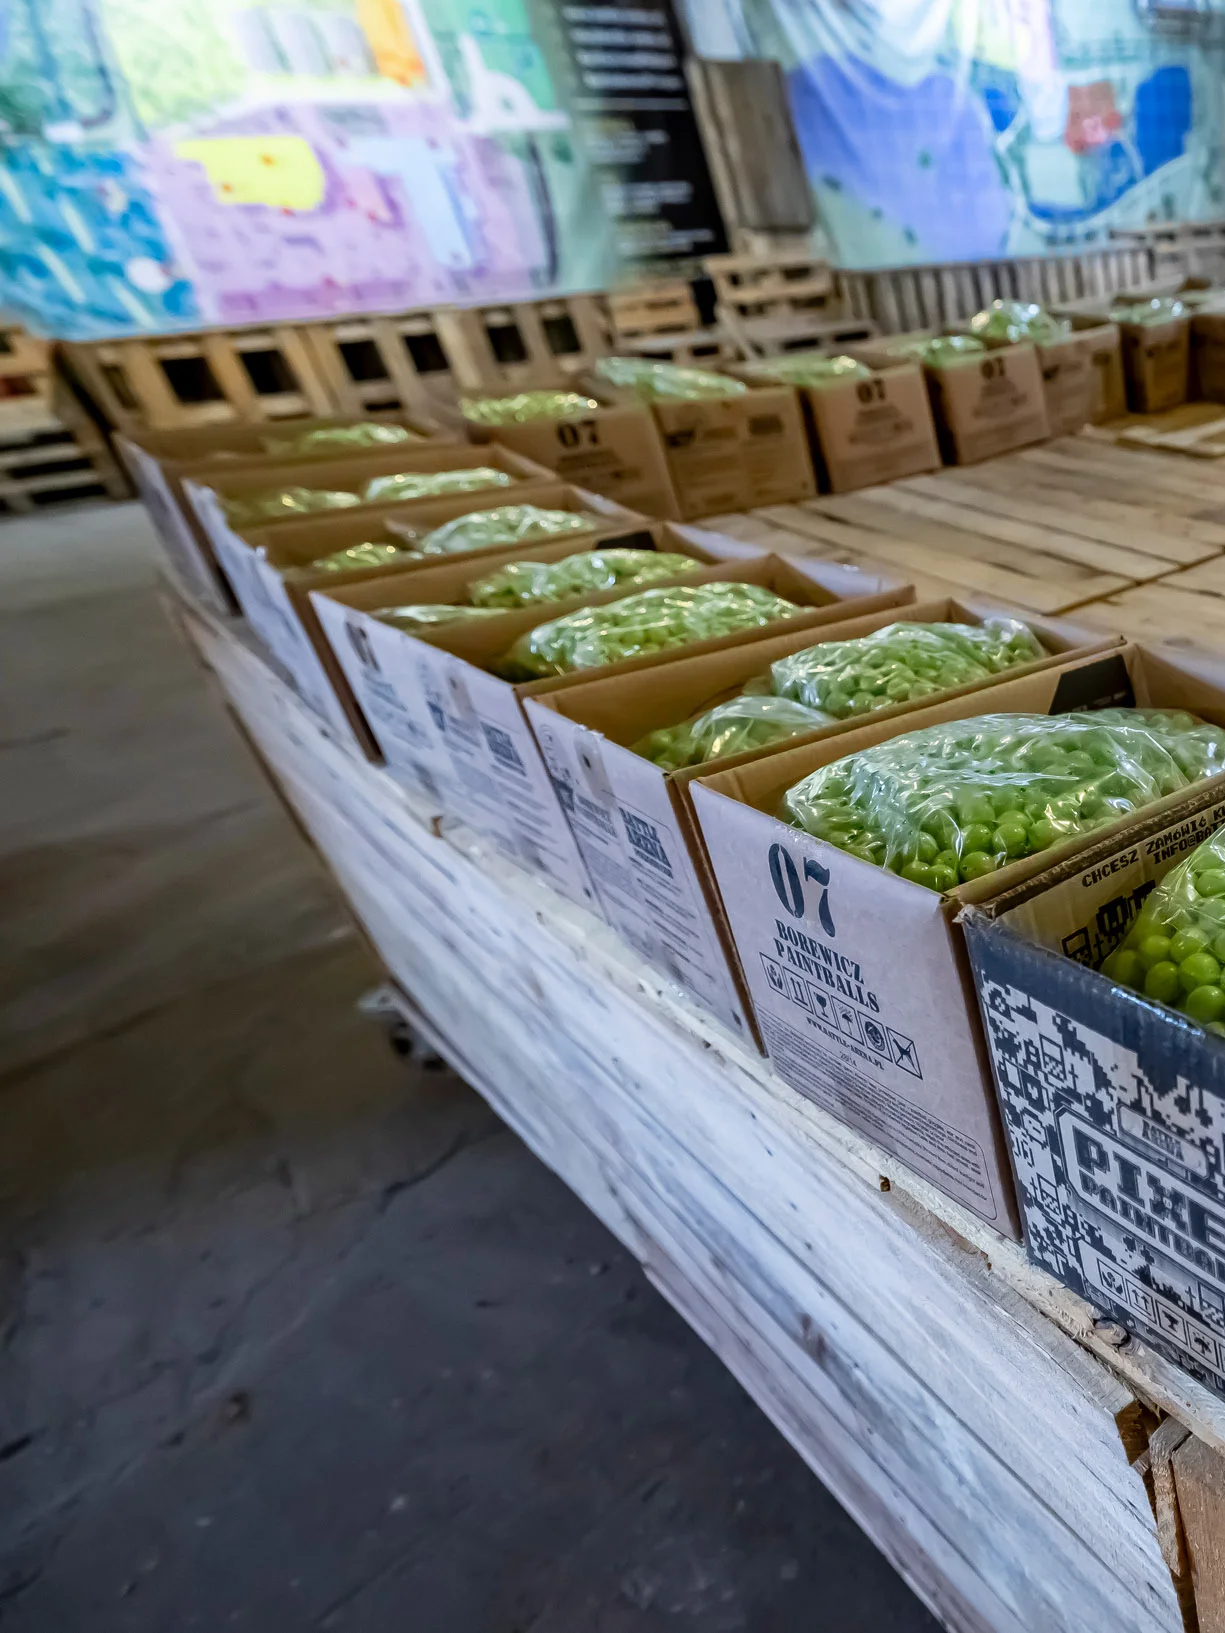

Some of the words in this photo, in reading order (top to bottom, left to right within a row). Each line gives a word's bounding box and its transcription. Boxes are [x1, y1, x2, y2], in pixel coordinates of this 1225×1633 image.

[556, 419, 599, 448] 07
[768, 843, 836, 938] 07
[1081, 851, 1139, 888] CHCESZ
[773, 937, 880, 1013] PAINTBALLS
[774, 918, 865, 985] BOREWICZ
